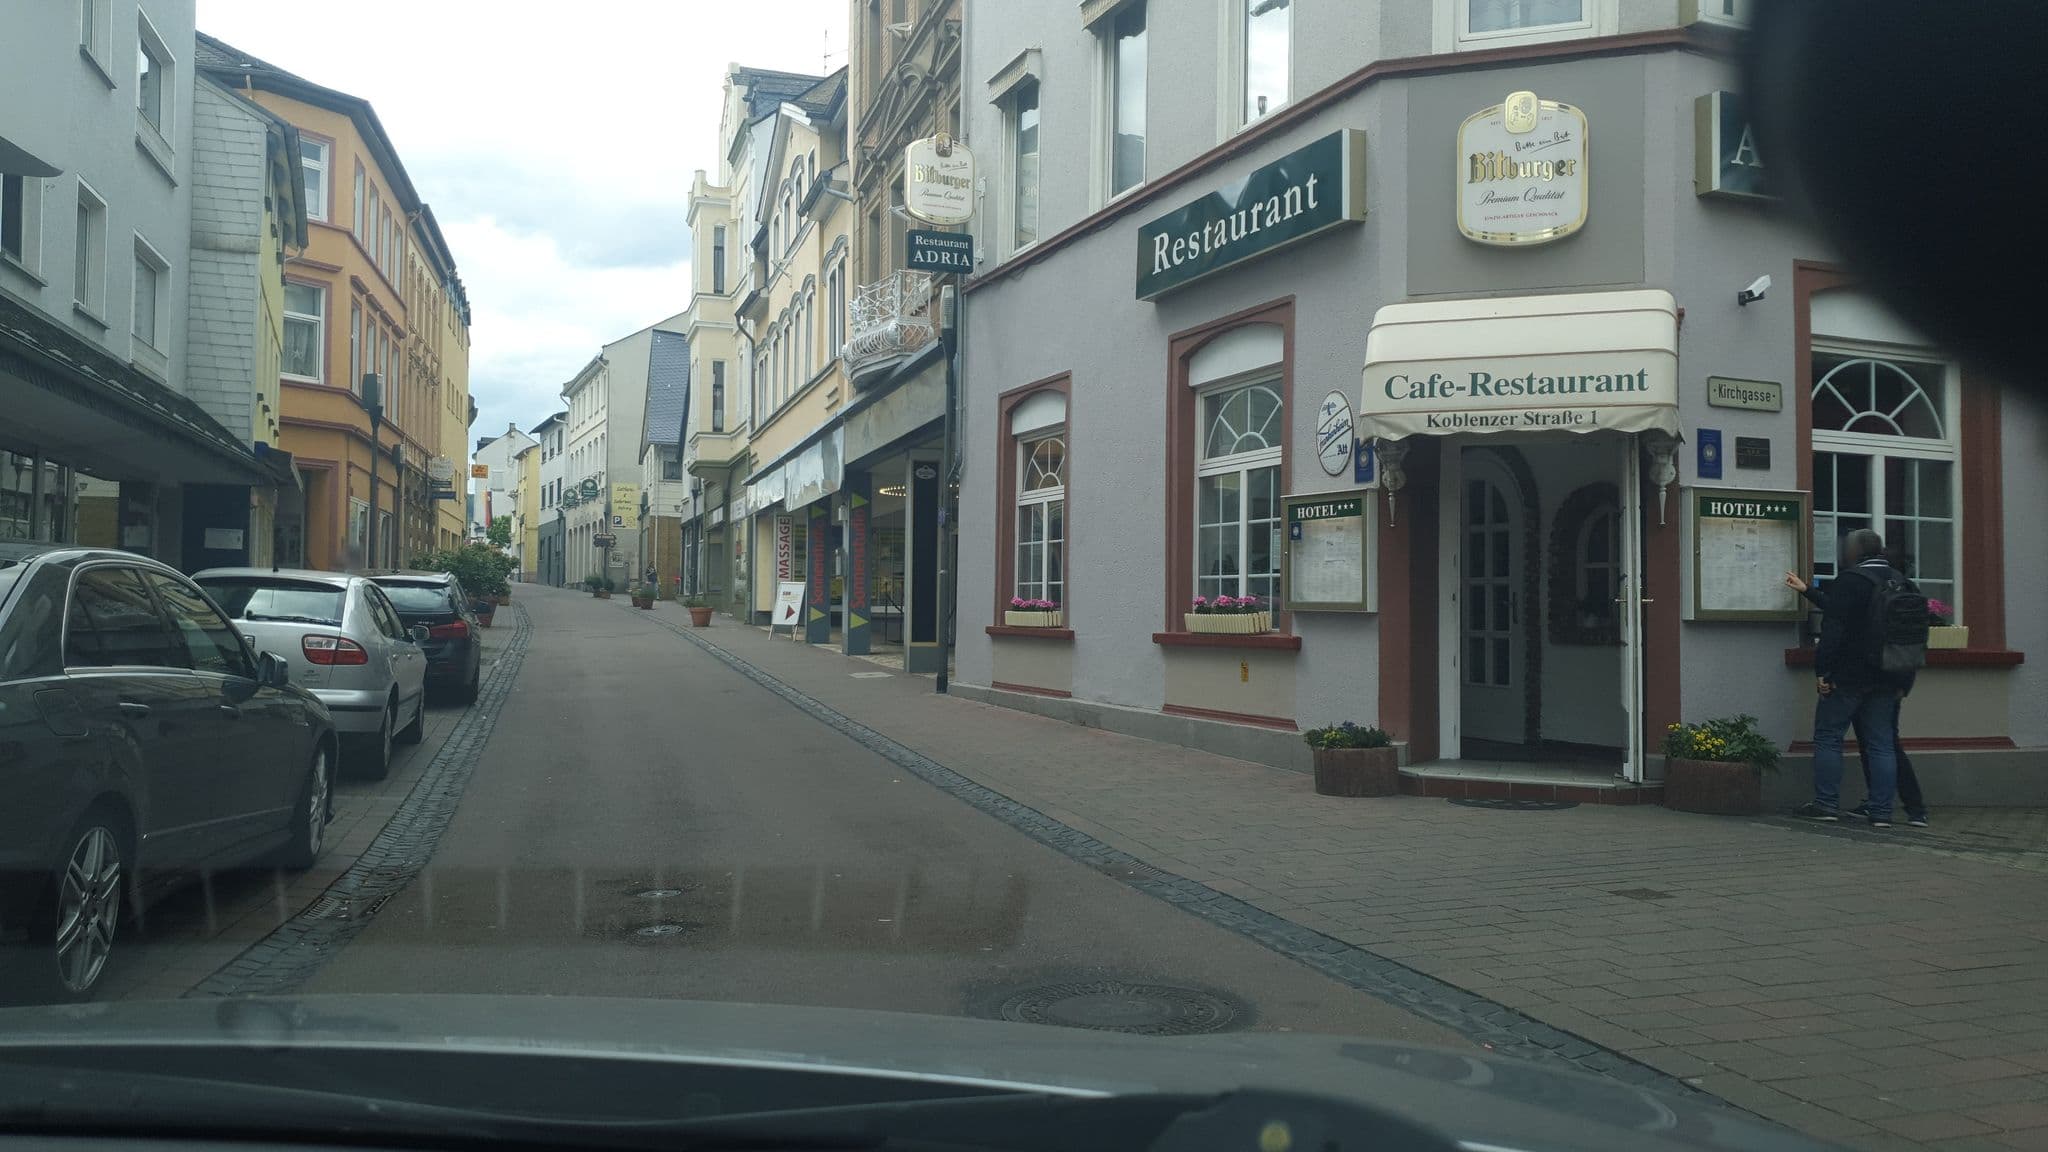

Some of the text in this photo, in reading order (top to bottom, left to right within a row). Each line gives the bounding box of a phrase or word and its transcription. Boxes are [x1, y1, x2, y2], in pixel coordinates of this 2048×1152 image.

[914, 163, 971, 190] Bitburger
[1468, 150, 1577, 184] Bitburger
[1475, 190, 1520, 206] Premium
[1152, 172, 1319, 276] Restaurant
[915, 235, 969, 249] Restaurant
[913, 250, 971, 267] ADRIA
[1384, 367, 1649, 400] Cafe-Restaurant
[1718, 383, 1771, 404] Kirchgasse
[1427, 409, 1598, 428] Koblenzer Straße 1
[1297, 504, 1337, 519] HOTEL
[1711, 502, 1766, 517] HOTEL
[779, 516, 790, 579] MASSAGE
